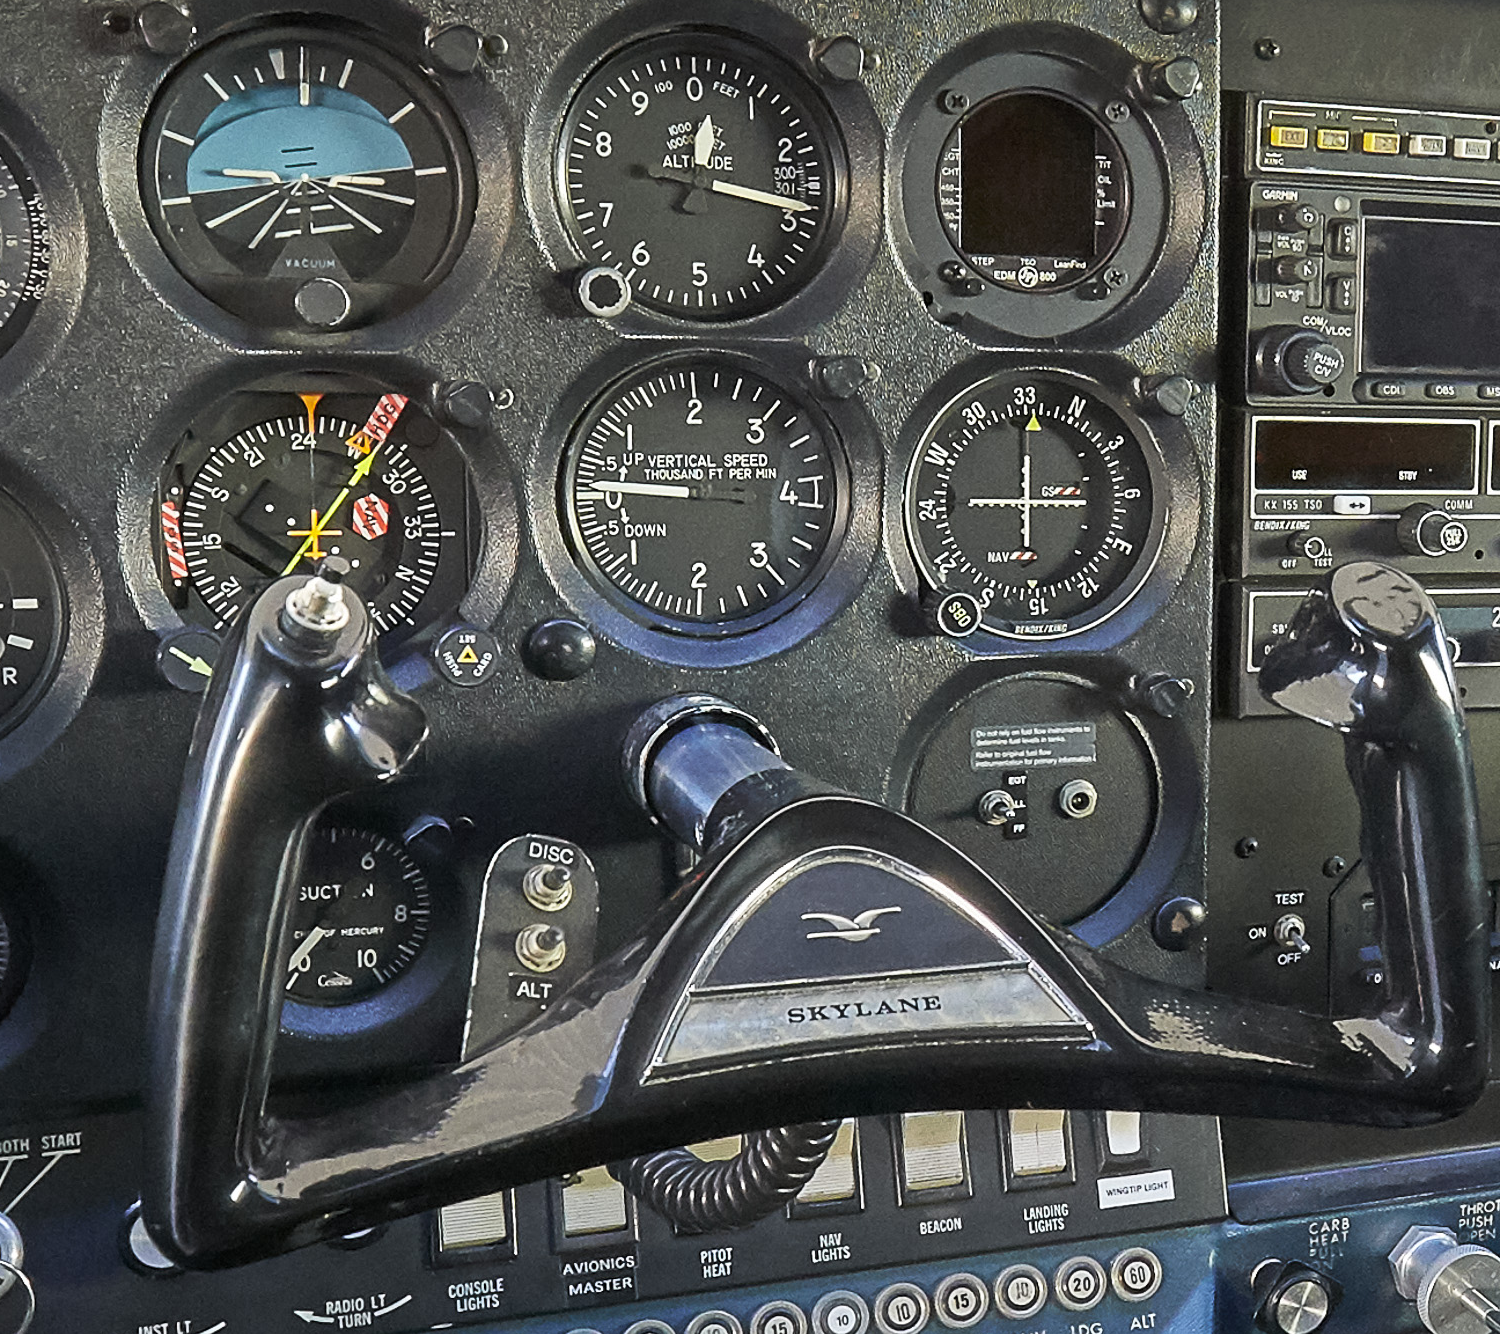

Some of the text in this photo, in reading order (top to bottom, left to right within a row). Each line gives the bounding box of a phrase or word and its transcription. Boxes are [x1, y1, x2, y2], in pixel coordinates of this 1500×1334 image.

[713, 82, 740, 99] FEET
[1262, 189, 1298, 201] GARMIN
[285, 259, 335, 268] VACUUM
[993, 271, 1016, 281] EDM
[1383, 384, 1400, 395] CDI
[1435, 385, 1454, 396] OBS
[648, 454, 768, 467] VERTICAL SPEED
[644, 468, 777, 480] THOUSAND FT PER MIN
[1444, 499, 1474, 510] COMM
[625, 524, 667, 537] DOWN
[1254, 521, 1310, 531] BENDIX/KING
[529, 842, 574, 865] DISC
[1275, 892, 1304, 905] TEST
[516, 981, 553, 999] ALT
[787, 995, 942, 1025] SKYLANE
[40, 1131, 83, 1151] START
[1105, 1179, 1170, 1198] WINGTIP LIGHT
[1022, 1203, 1069, 1221] LANDING
[919, 1216, 962, 1234] BEACON
[1027, 1215, 1065, 1234] LIGHTS
[1308, 1217, 1351, 1235] CARB
[1458, 1215, 1495, 1230] PUSH
[819, 1232, 842, 1249] NAV
[1309, 1231, 1350, 1247] HEAT
[700, 1247, 733, 1265] PITOT
[811, 1244, 851, 1263] LIGHTS
[562, 1255, 635, 1276] AVIONICS
[702, 1261, 733, 1278] HEAT
[448, 1278, 505, 1299] CONSOLE
[568, 1276, 633, 1296] MASTER
[325, 1293, 386, 1317] RADIO LT
[456, 1294, 500, 1313] LIGHTS
[176, 1320, 191, 1334] LT
[337, 1311, 372, 1328] TURN
[1129, 1312, 1157, 1330] ALT
